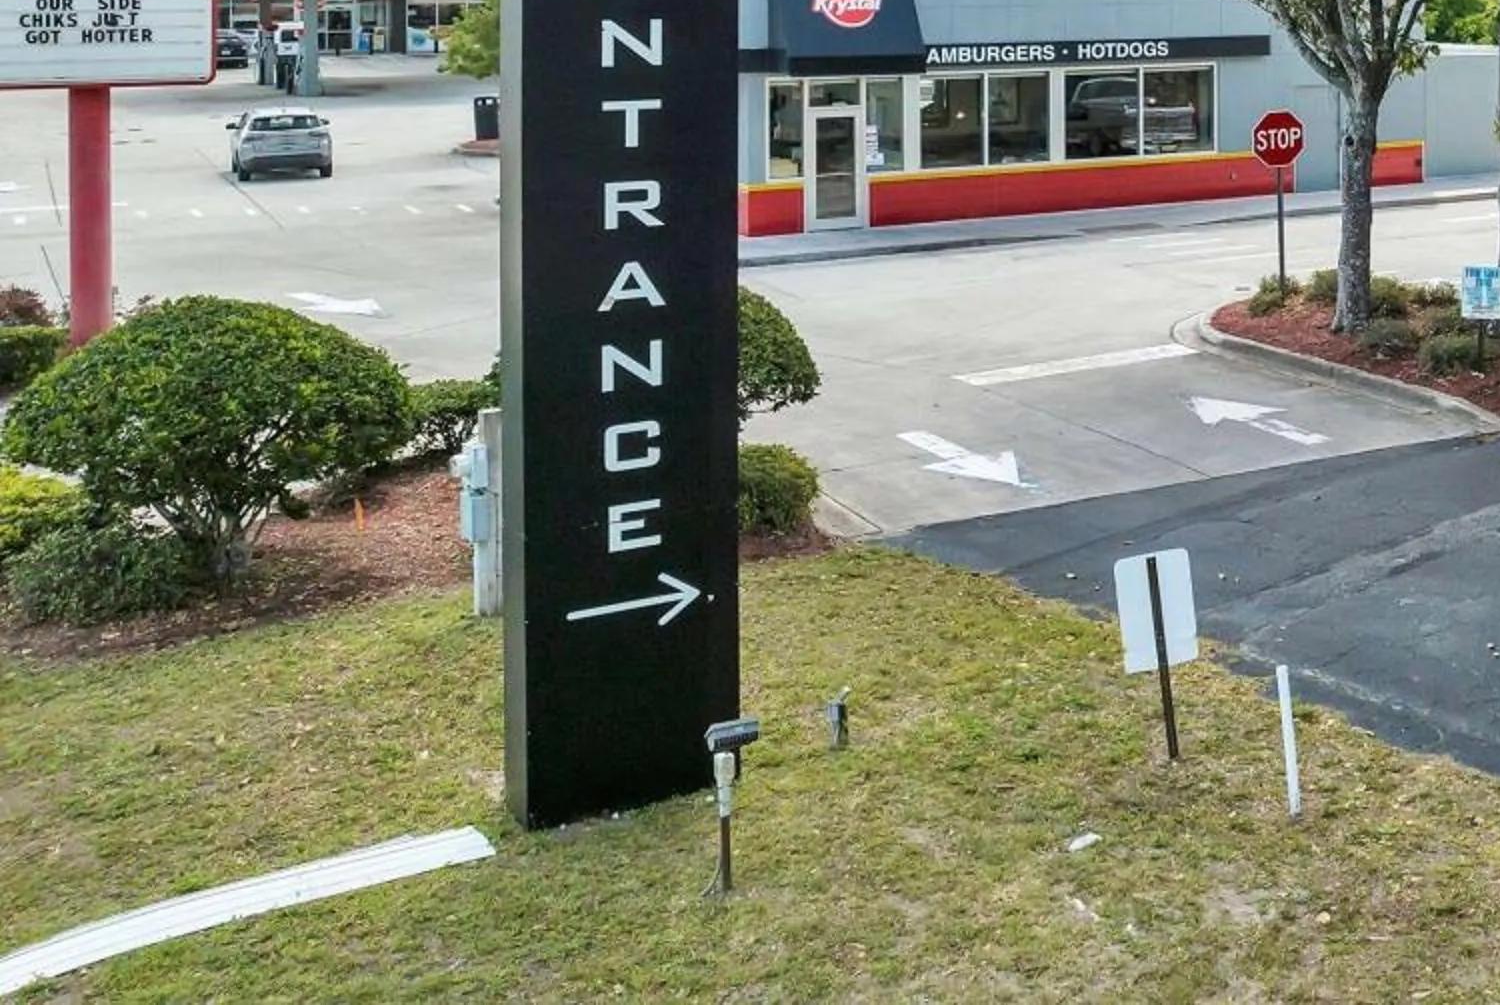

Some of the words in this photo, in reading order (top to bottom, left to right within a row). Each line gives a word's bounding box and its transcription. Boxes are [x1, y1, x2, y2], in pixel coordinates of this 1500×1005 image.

[19, 13, 78, 28] CHIKS
[25, 30, 61, 44] GOT
[81, 28, 153, 43] HOTTER
[926, 45, 1055, 64] AMBURGERS
[1078, 41, 1169, 59] HOTDOGS
[1256, 127, 1301, 151] STOP
